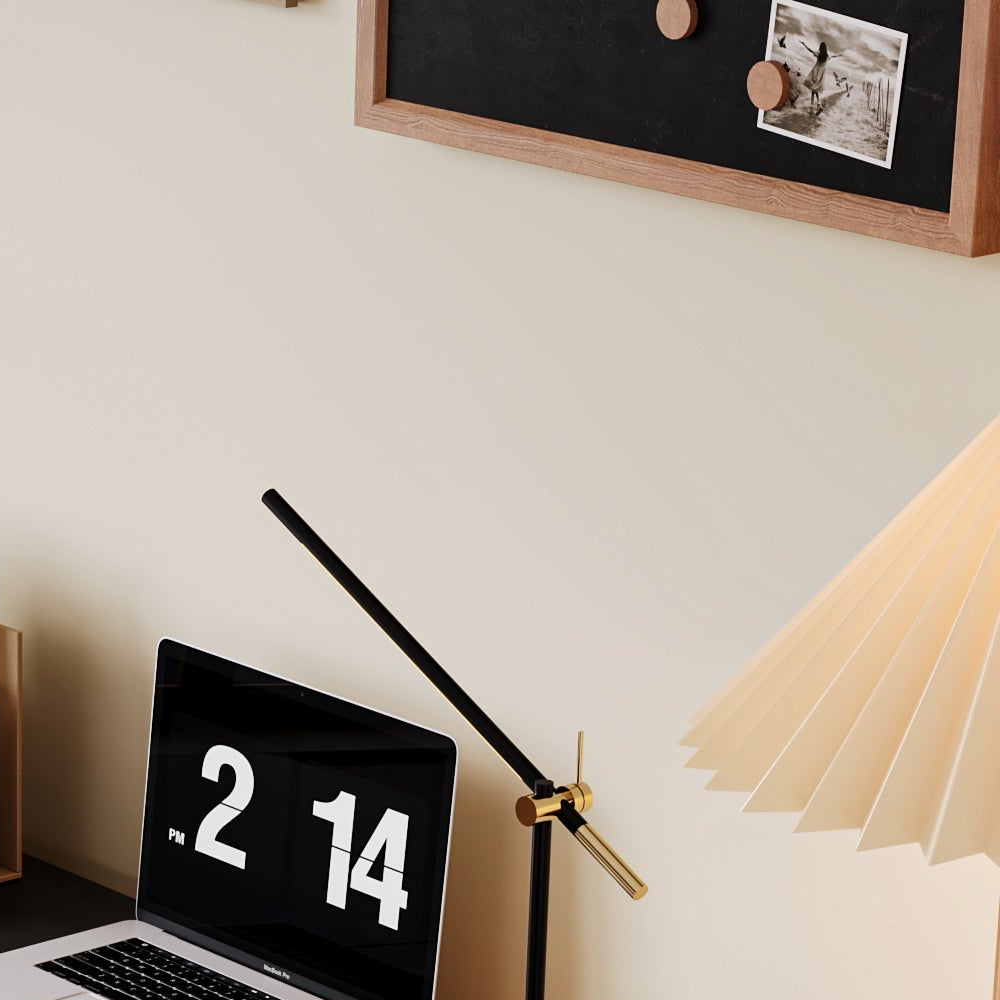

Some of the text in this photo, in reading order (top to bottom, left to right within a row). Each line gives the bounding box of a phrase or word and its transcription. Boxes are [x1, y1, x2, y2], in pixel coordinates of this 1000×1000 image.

[168, 827, 185, 846] PM
[194, 744, 409, 931] 2 14
[263, 963, 291, 980] MacBook Pro
